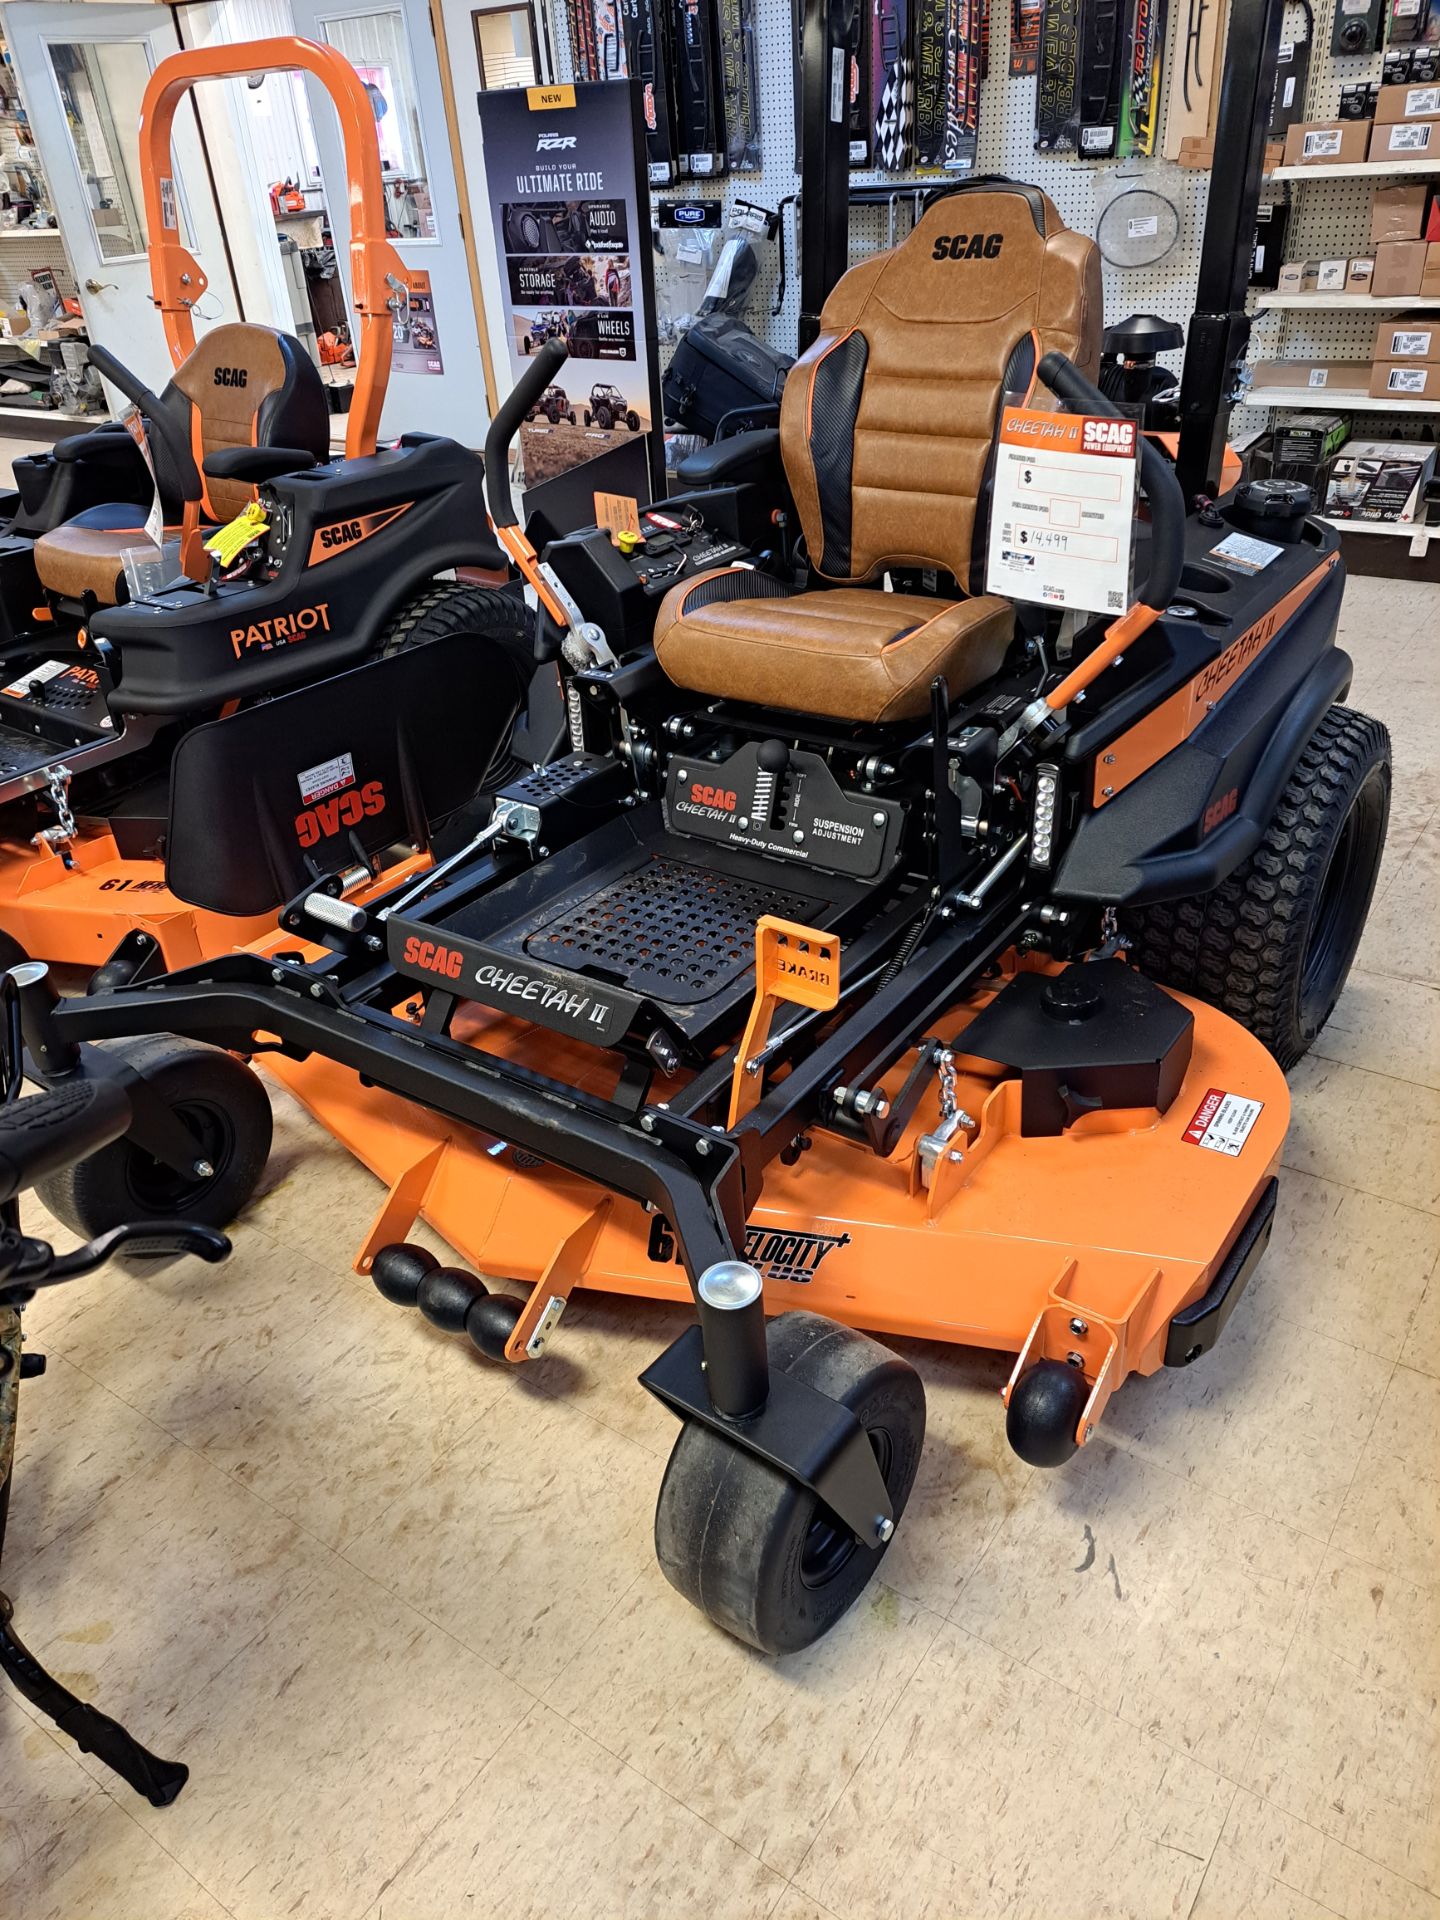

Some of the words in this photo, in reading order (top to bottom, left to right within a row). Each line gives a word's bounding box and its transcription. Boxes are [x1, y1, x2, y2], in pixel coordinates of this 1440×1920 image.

[541, 95, 562, 103] NEW
[536, 137, 577, 152] RZR
[516, 174, 573, 194] ULTIMATE
[577, 172, 604, 191] RIDE
[589, 210, 616, 226] AUDIO
[931, 233, 1004, 260] SCAG
[519, 273, 556, 288] STORAGE
[597, 320, 631, 336] WHEELS
[214, 367, 248, 388] SCAG
[1006, 418, 1066, 439] CHEETAH
[1068, 426, 1079, 439] II
[1084, 421, 1133, 445] SCAG
[1083, 442, 1101, 451] POWER
[1102, 444, 1132, 454] EQUIPMENT
[1024, 470, 1032, 484] $
[320, 521, 362, 548] SCAG
[1020, 530, 1028, 544] $
[1030, 530, 1068, 551] 14,499
[230, 604, 331, 660] PATRIOT
[287, 632, 307, 643] SCAG
[1196, 620, 1265, 702] CHEETAH
[311, 783, 339, 800] DANGER
[691, 783, 737, 812] SCAG
[295, 781, 386, 848] SCAG
[676, 801, 728, 822] CHEETAH
[728, 814, 737, 824] II
[811, 829, 862, 845] ADJUSTMENT
[813, 818, 865, 837] SUSPENSION
[729, 832, 767, 850] Heavy-Duty
[768, 842, 808, 858] Commercial
[99, 879, 133, 891] 61
[404, 936, 464, 980] SCAG
[475, 965, 590, 1018] CHEETAH
[588, 1003, 610, 1024] II
[1195, 1095, 1222, 1128] DANGER
[744, 1231, 835, 1269] ELOCITY
